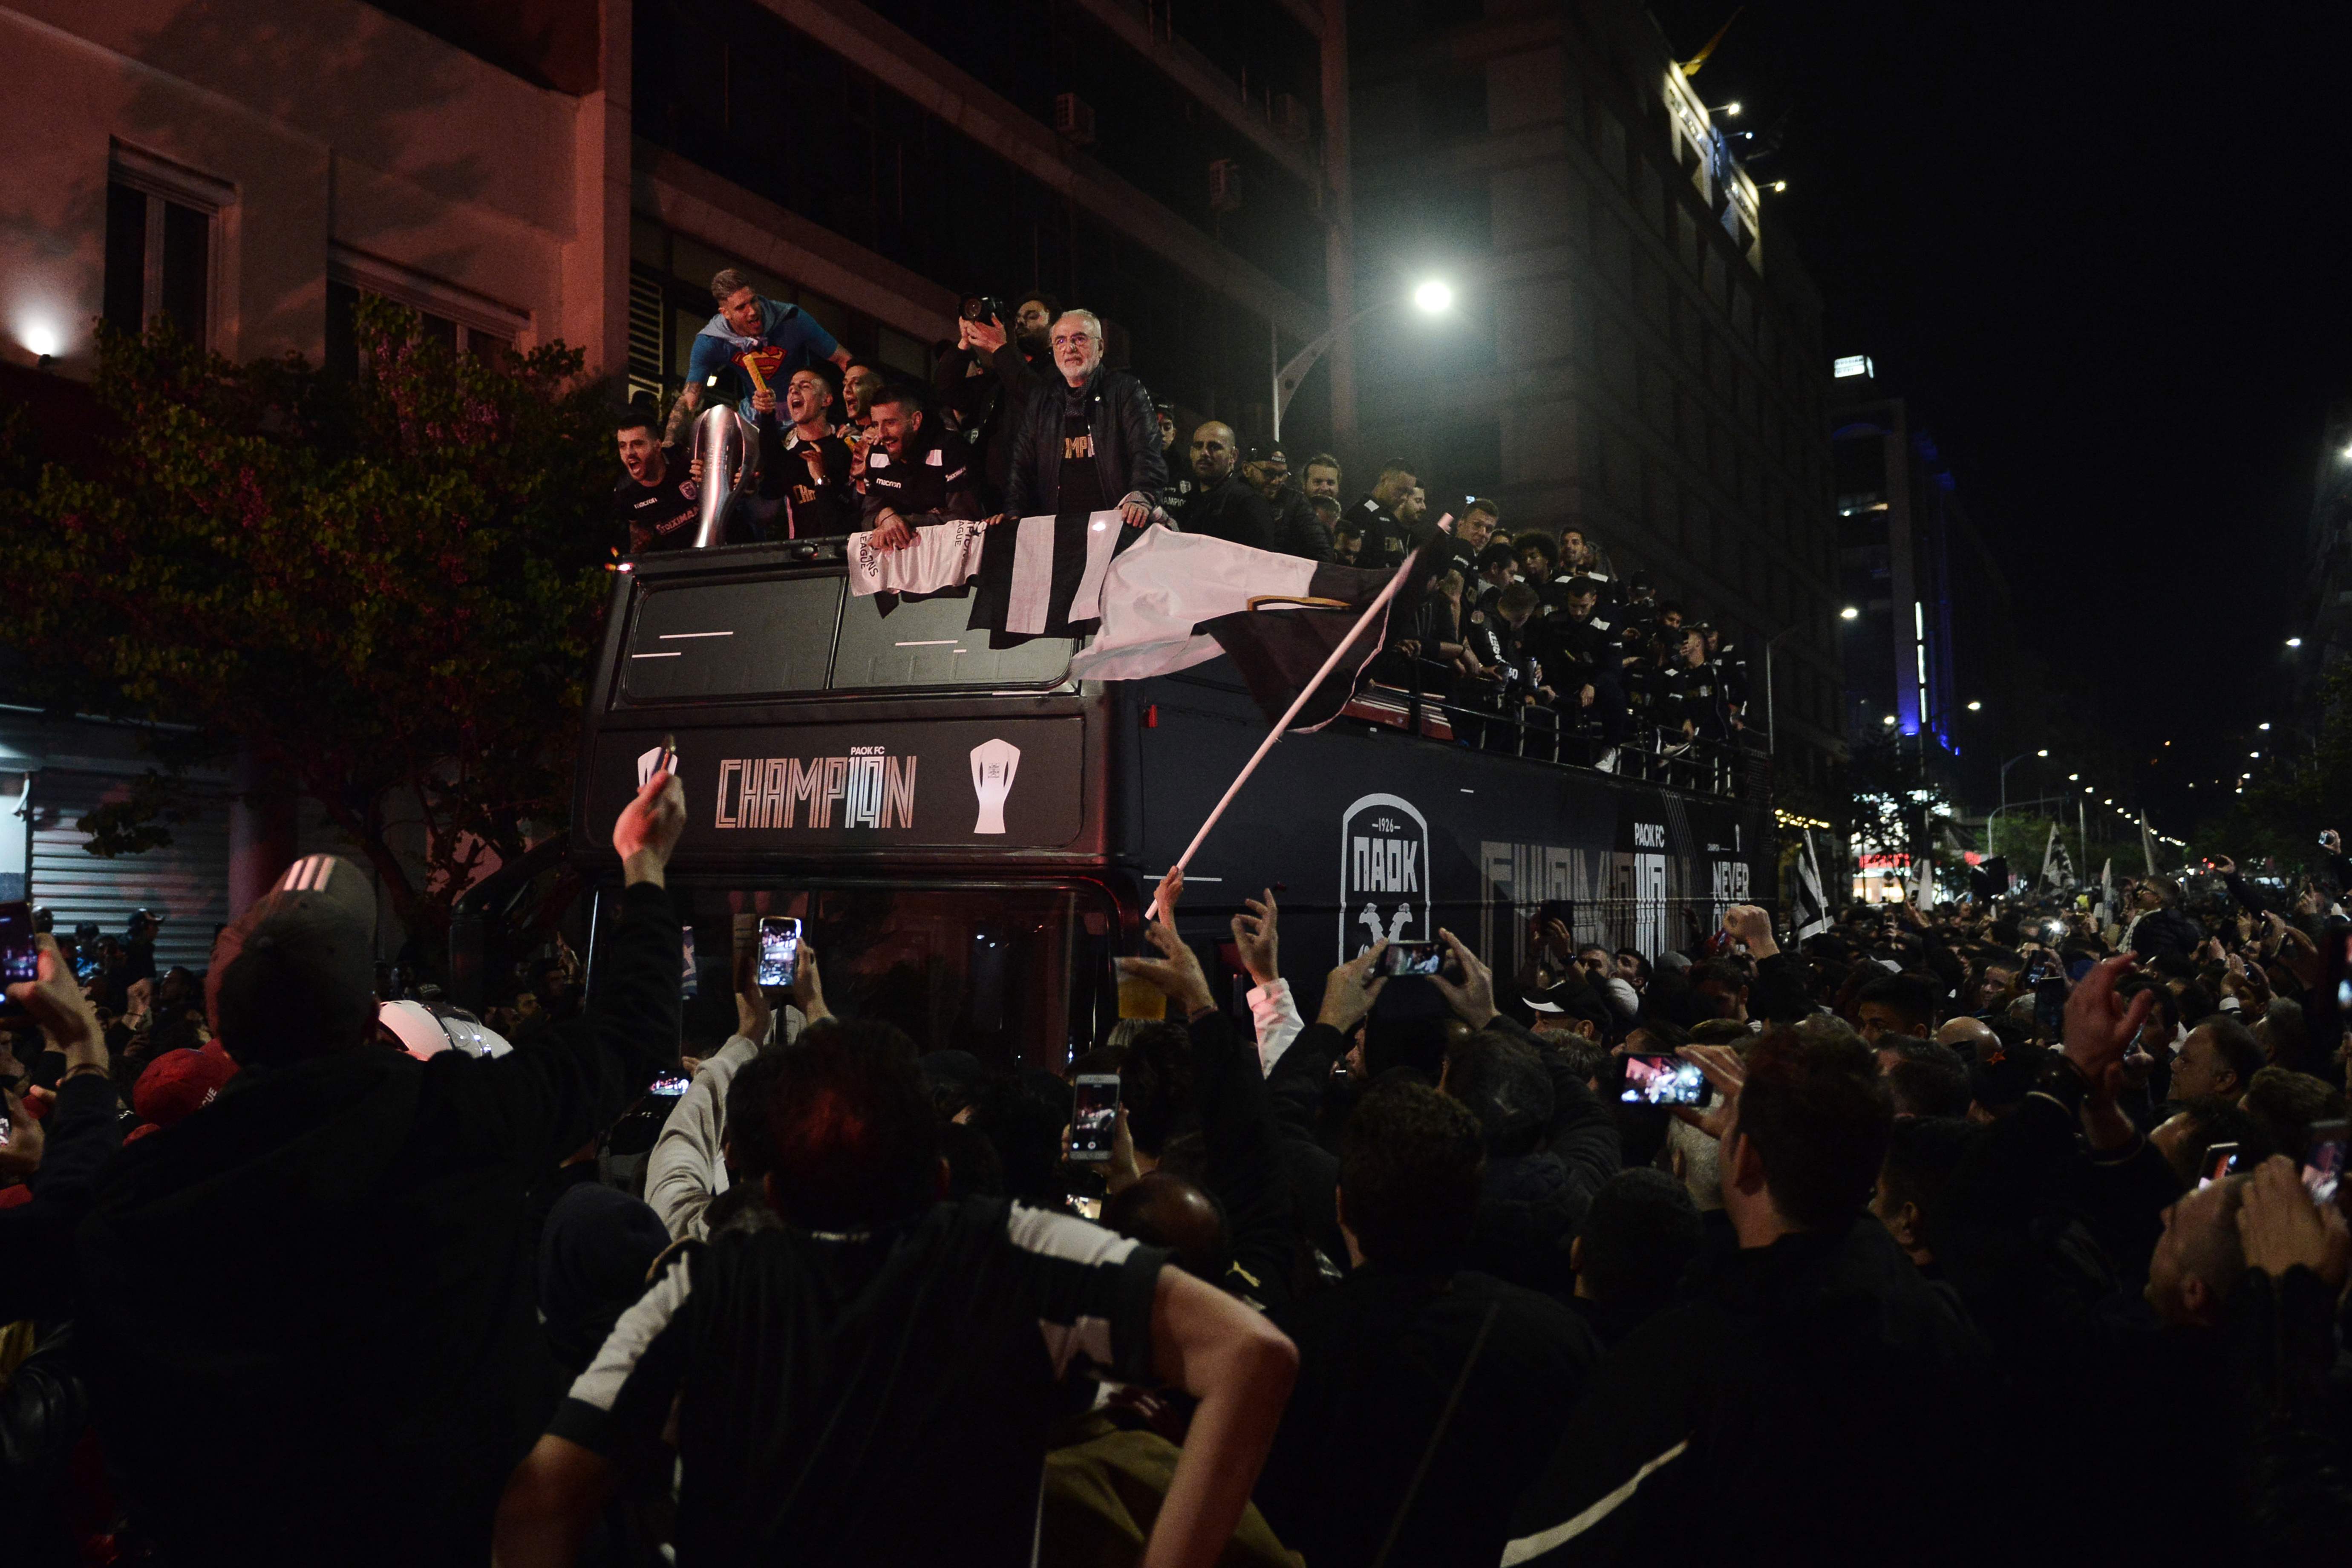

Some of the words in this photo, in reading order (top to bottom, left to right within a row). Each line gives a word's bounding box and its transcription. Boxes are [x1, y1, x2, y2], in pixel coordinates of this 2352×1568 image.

[876, 477, 902, 489] macron
[634, 497, 658, 510] macron
[850, 747, 873, 755] PAOK
[874, 746, 885, 755] FC
[1634, 822, 1655, 847] PAOK
[1655, 824, 1665, 848] FC
[1354, 836, 1418, 892] ΠΑΟΚ
[1712, 860, 1750, 901] NEVER
